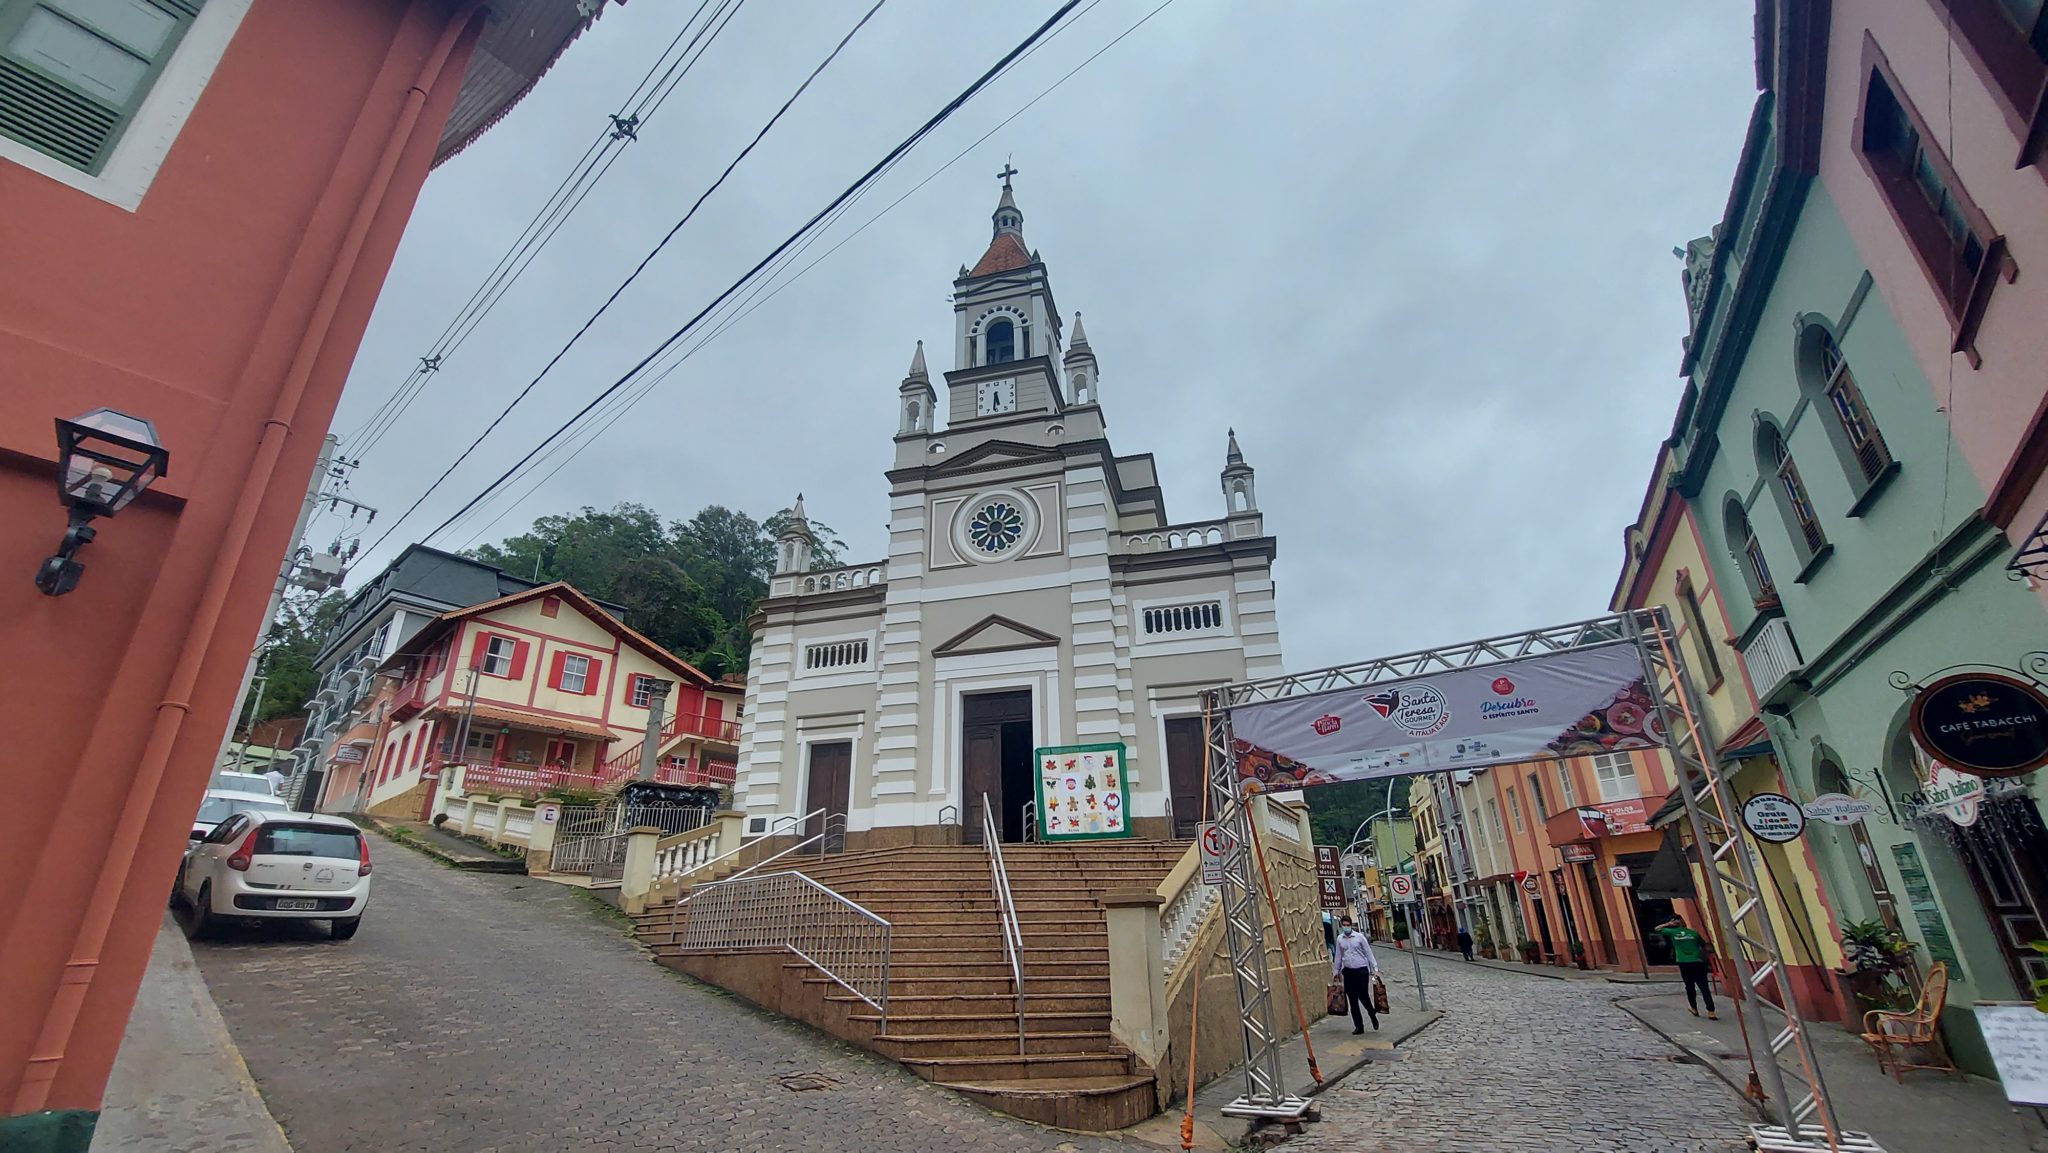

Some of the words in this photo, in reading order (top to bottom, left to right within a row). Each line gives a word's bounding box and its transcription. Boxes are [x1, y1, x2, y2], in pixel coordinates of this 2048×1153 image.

[1401, 692, 1439, 708] Santa
[1480, 697, 1536, 713] Descubra
[1397, 706, 1436, 720] Teresa
[1516, 708, 1539, 716] SANTO
[1404, 714, 1437, 723] GOURMET
[1972, 714, 2038, 729] TABACCHI
[1806, 806, 1832, 814] Sabor
[1835, 804, 1870, 813] Italiano
[1752, 822, 1799, 831] Imigrante
